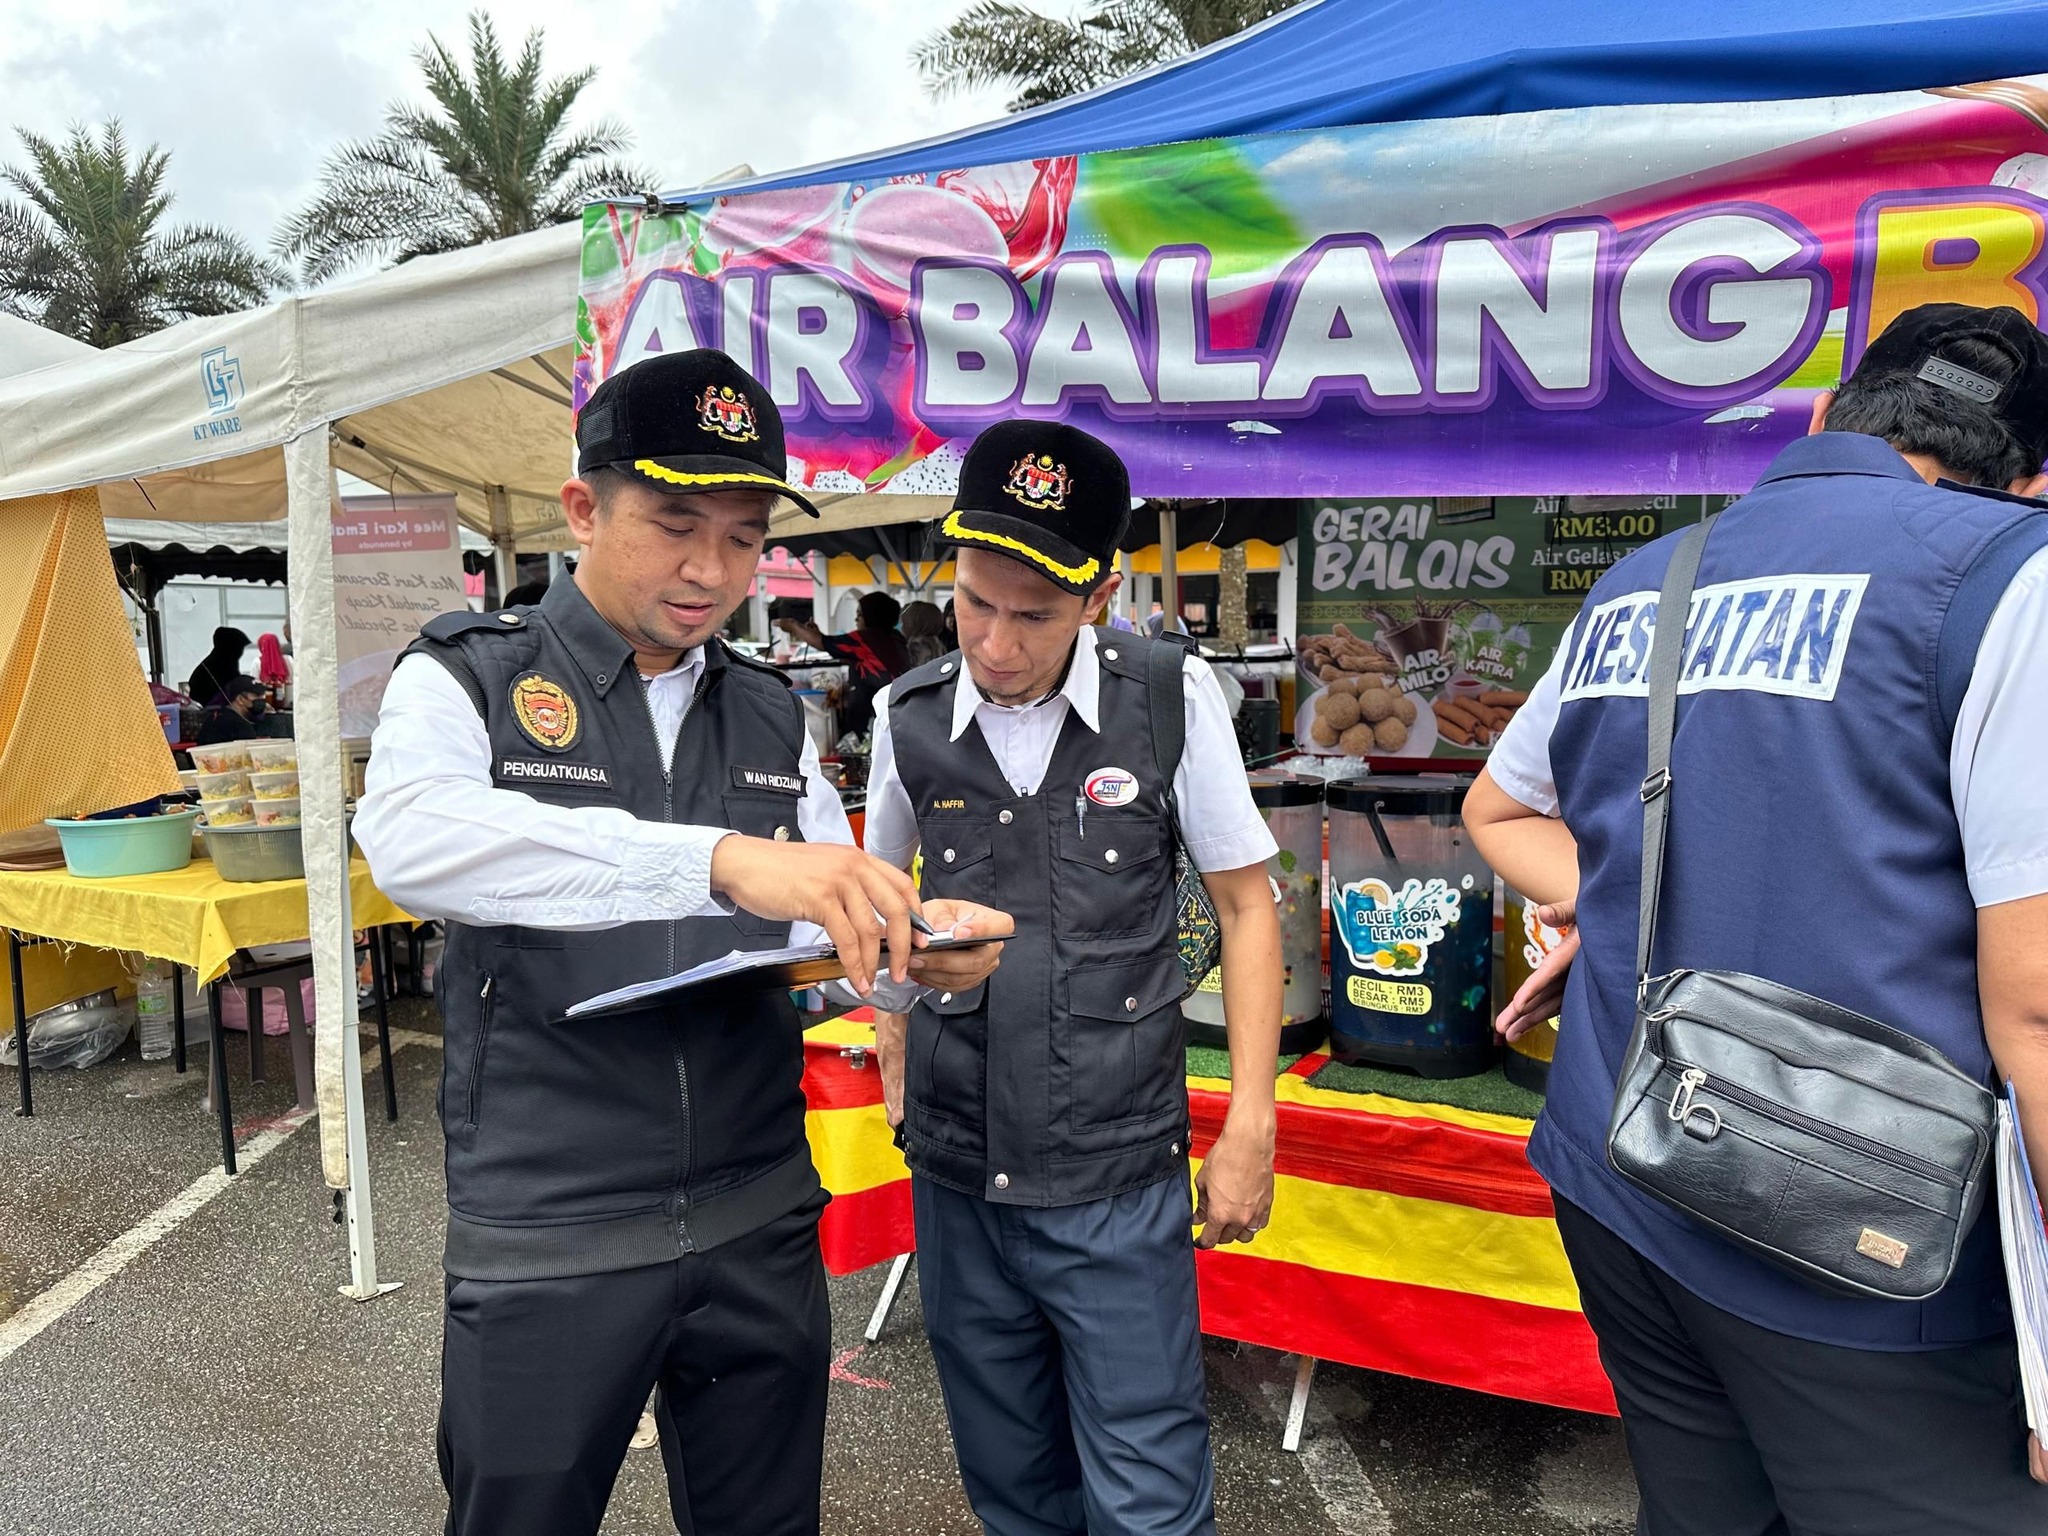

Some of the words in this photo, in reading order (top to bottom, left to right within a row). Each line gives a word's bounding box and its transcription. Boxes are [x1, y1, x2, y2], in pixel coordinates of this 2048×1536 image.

[607, 273, 864, 405] AIR
[919, 211, 1815, 406] BALANG
[193, 424, 208, 441] KT
[208, 417, 242, 437] WARE
[1312, 504, 1433, 543] GERAI
[1552, 515, 1656, 538] RM3.00
[1312, 535, 1516, 592] BALQIS
[1530, 547, 1563, 566] Air
[1566, 546, 1621, 566] Gelas
[1571, 588, 1852, 691] KESHATAN
[1404, 649, 1441, 673] AIR
[1477, 646, 1503, 662] AIR
[1396, 666, 1451, 694] MILO
[1465, 659, 1515, 681] KATIRA
[503, 761, 608, 783] PENGUATKUASA
[744, 771, 768, 785] WAN
[767, 774, 802, 791] RIDZUAN
[941, 799, 965, 809] HAFFIR
[1357, 911, 1393, 925] BLUE
[1401, 908, 1442, 924] SODA
[1372, 926, 1428, 941] LEMON
[1352, 978, 1386, 993] KECIL
[1396, 985, 1424, 996] RM3
[1352, 988, 1389, 1003] BESAR
[1399, 996, 1425, 1006] RM5
[1352, 997, 1399, 1012] SEBUNGKUS
